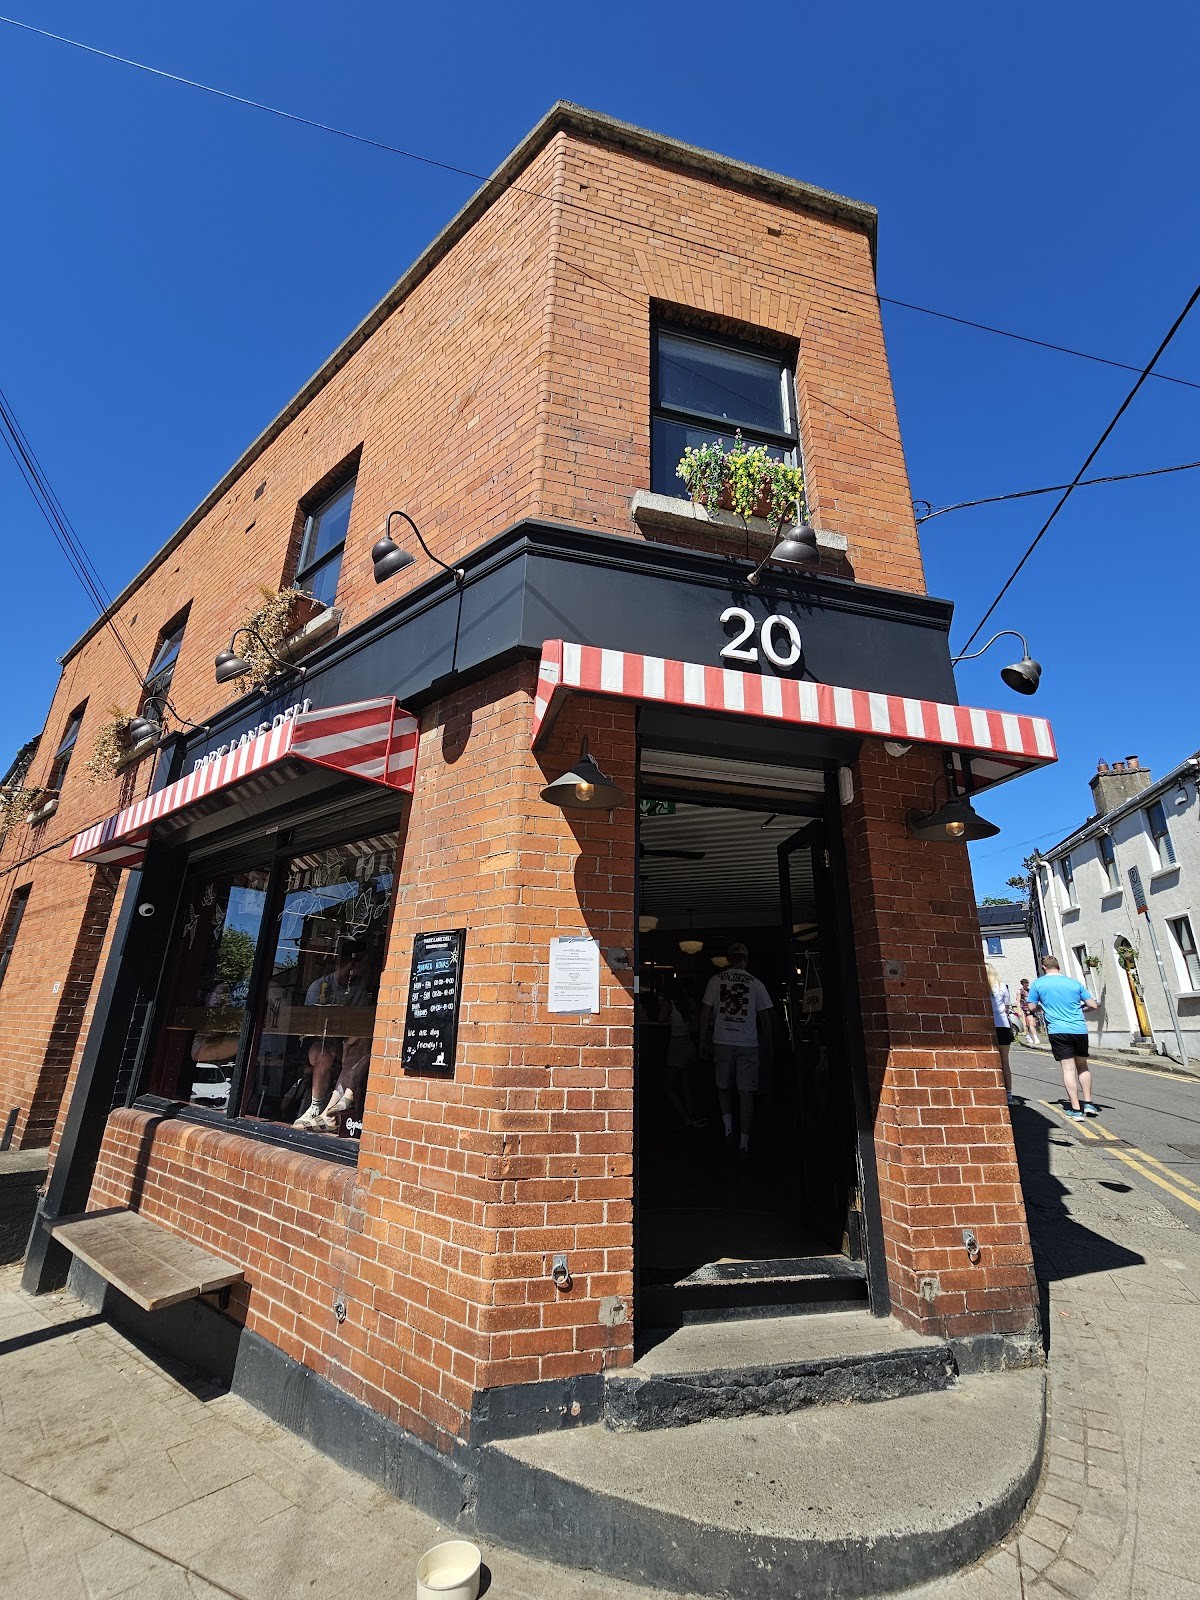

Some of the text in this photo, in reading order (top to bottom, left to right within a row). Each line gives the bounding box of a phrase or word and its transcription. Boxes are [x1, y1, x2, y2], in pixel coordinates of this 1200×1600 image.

[719, 606, 802, 667] 20
[194, 698, 313, 772] PARK LANE DELI
[435, 960, 450, 969] HOURS
[418, 1029, 428, 1037] are
[429, 1027, 440, 1039] dog
